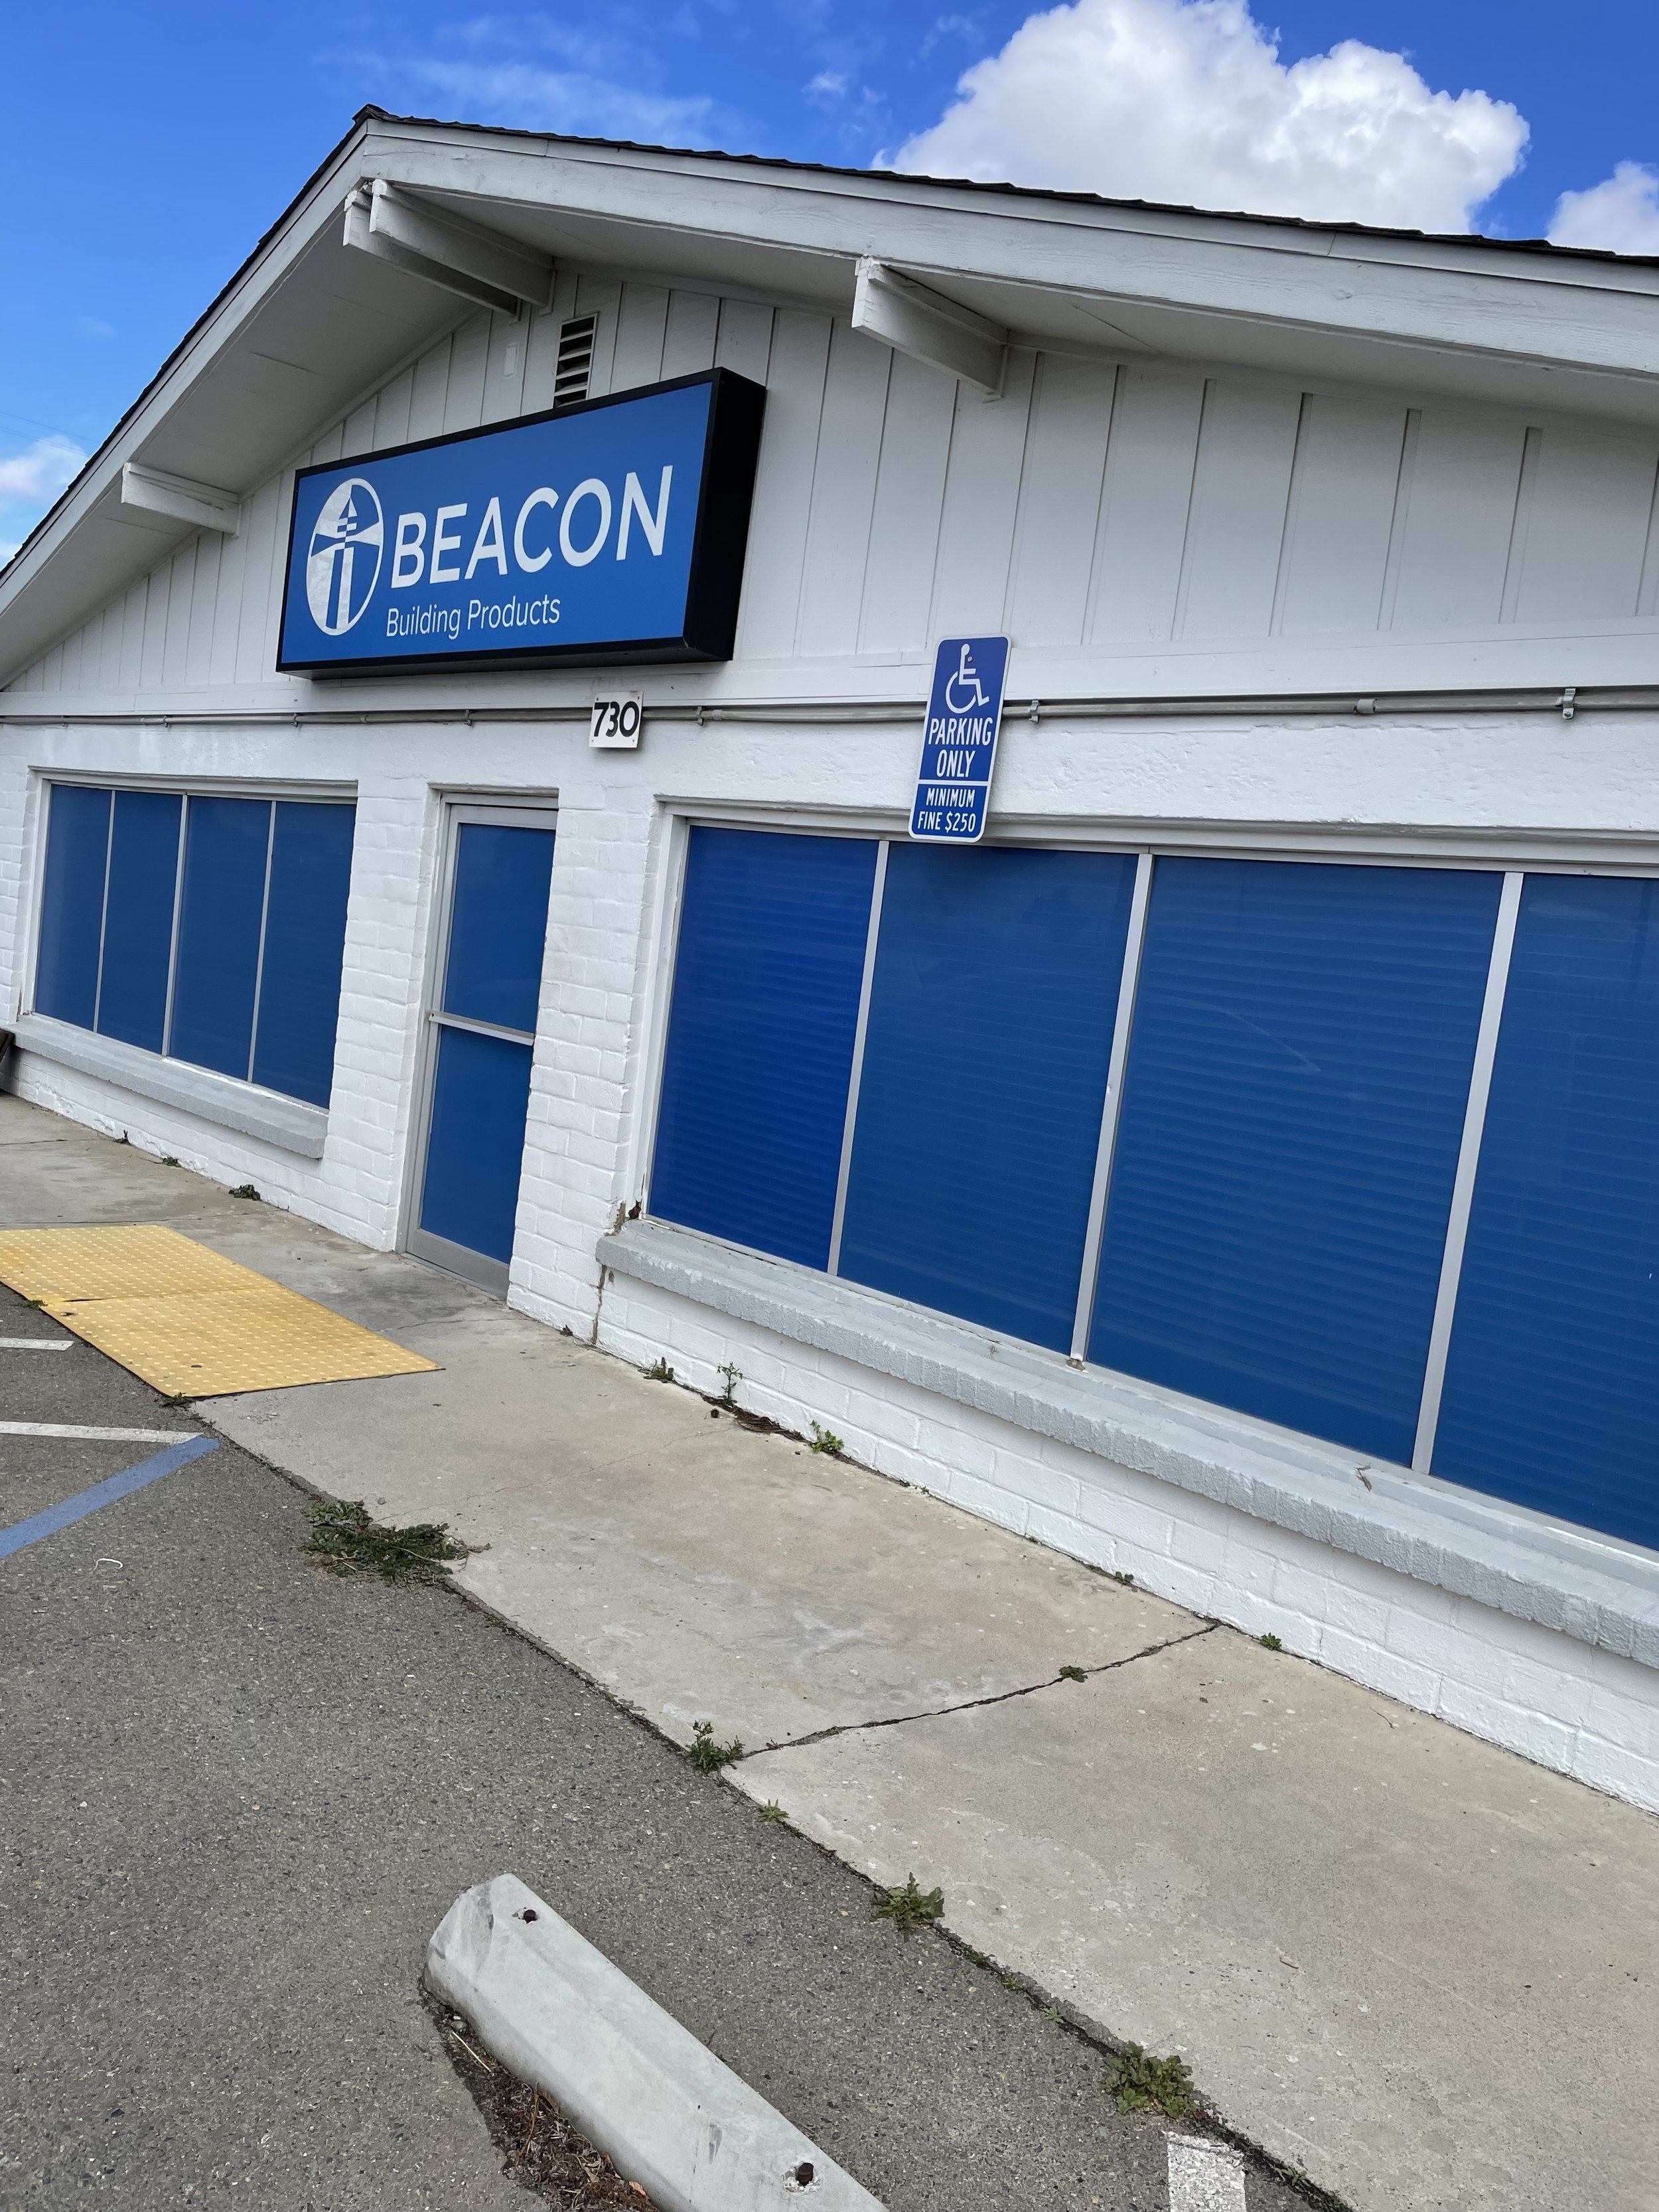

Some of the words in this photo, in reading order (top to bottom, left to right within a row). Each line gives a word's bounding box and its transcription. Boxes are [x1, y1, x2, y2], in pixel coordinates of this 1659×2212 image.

[391, 465, 674, 589] BEACON
[387, 605, 461, 640] Building
[467, 595, 561, 631] Products
[594, 701, 640, 737] 730
[928, 717, 993, 746] PARKING
[936, 749, 975, 778] ONLY
[926, 787, 975, 808] MINIMUM
[917, 810, 942, 830] FINE
[945, 811, 976, 834] $250
